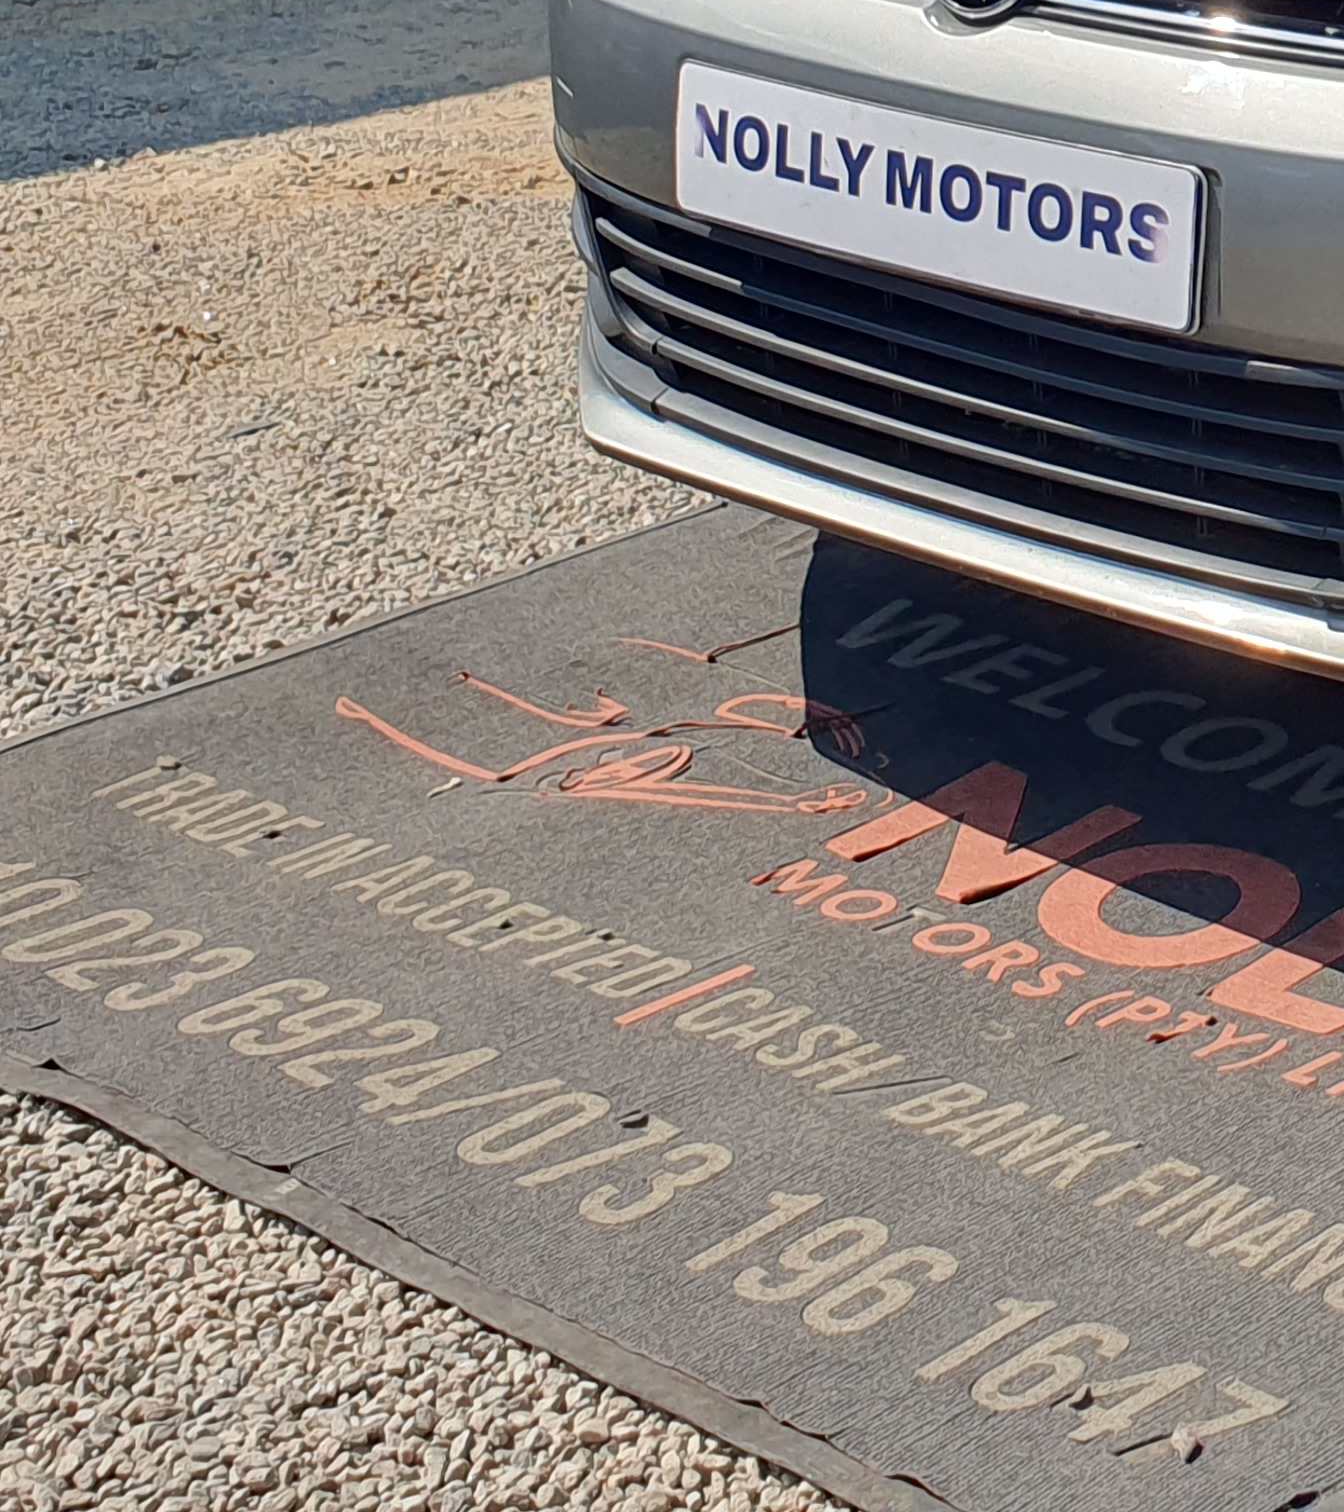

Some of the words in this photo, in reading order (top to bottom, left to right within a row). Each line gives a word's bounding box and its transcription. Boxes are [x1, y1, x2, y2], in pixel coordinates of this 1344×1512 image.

[694, 103, 875, 198] NOLLY
[885, 149, 1171, 263] MOTORS
[91, 755, 326, 857] TRADE
[266, 832, 393, 879] IN
[330, 855, 693, 998] ACCEPTED
[749, 858, 1087, 999] MOTORS
[684, 1191, 959, 1336] 196
[914, 1298, 1292, 1466] 1647
